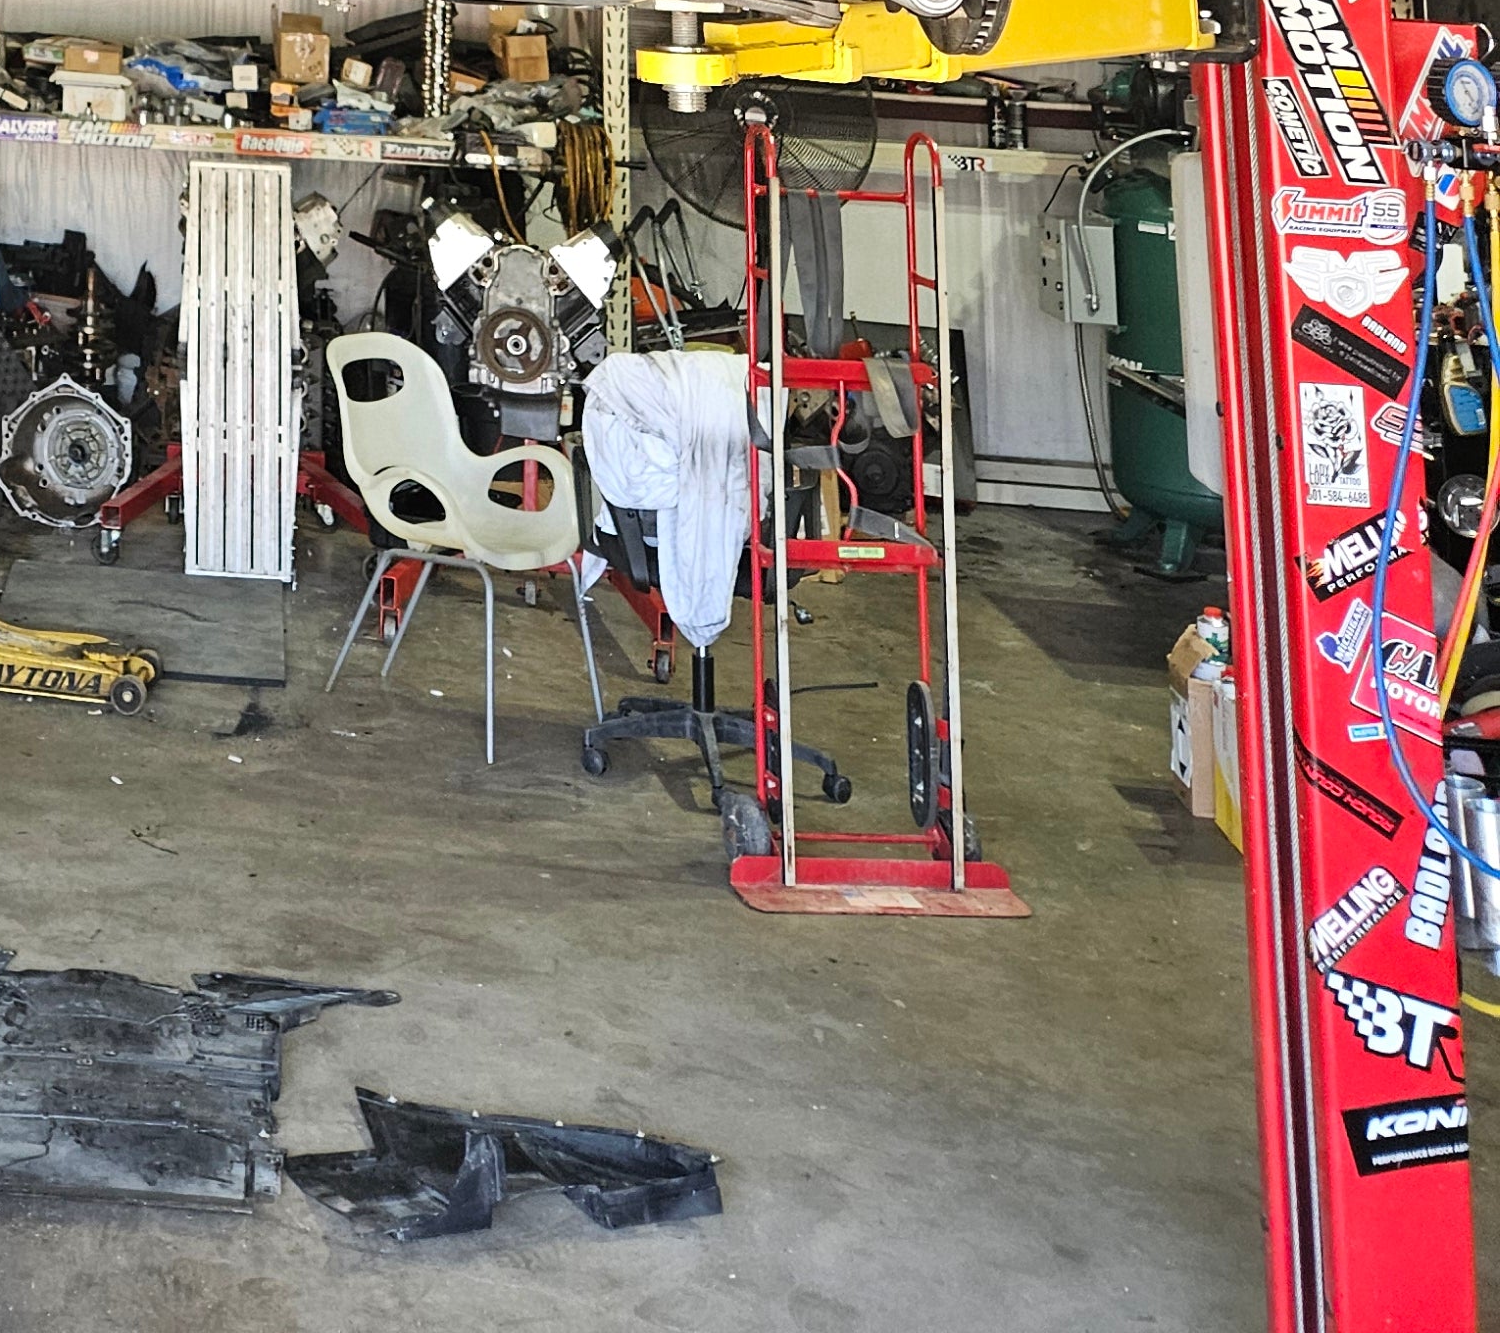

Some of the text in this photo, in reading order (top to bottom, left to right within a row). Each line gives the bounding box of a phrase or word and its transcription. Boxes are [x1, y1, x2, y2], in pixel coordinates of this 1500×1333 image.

[74, 134, 154, 149] MOTION
[956, 155, 987, 172] BTR
[1276, 192, 1365, 225] SUMMIT
[1372, 202, 1401, 218] 55
[1288, 225, 1317, 233] RACING
[1360, 314, 1408, 354] BADLAND
[1339, 475, 1362, 486] TATTOO
[1405, 780, 1450, 950] BADLA
[1310, 866, 1396, 962] MELLING
[1318, 890, 1405, 973] PERFORMANCE
[1366, 1097, 1468, 1141] KONI
